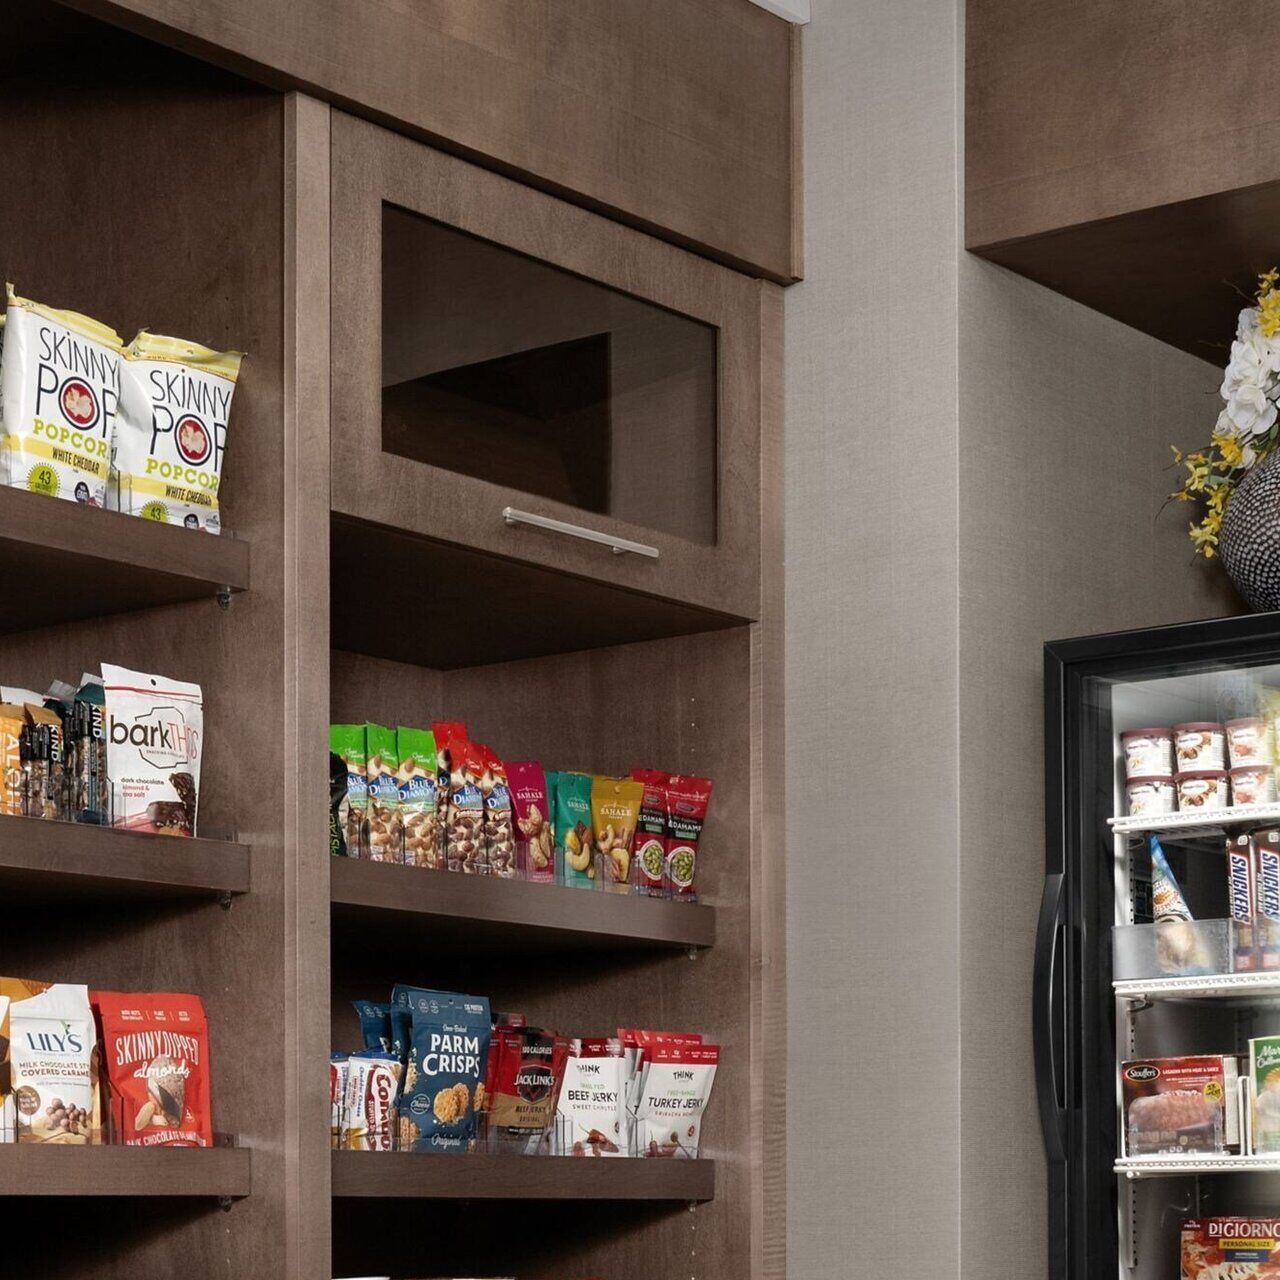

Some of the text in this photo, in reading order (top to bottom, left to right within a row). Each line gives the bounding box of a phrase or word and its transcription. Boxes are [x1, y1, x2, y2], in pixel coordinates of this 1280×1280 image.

[36, 363, 118, 438] POP
[150, 405, 227, 472] POP
[52, 448, 100, 474] WHITE CHEDDAR
[39, 471, 51, 485] 43
[185, 489, 212, 506] CHEDDAR
[90, 704, 101, 739] KIND
[49, 724, 58, 761] KIND
[409, 779, 429, 789] BLUE
[600, 808, 632, 816] SAHALE
[1231, 855, 1249, 922] SNICKERS
[27, 1031, 82, 1053] LILY'S
[431, 1034, 479, 1054] PARM
[21, 1070, 60, 1078] COVERED
[40, 1061, 78, 1069] CHOCOLATE
[133, 1061, 191, 1080] almonds
[422, 1053, 480, 1078] CRISPS
[514, 1074, 533, 1086] JACK
[673, 1071, 694, 1081] THINK
[568, 1090, 618, 1101] BEEF JERKY
[648, 1096, 682, 1108] TURKEY
